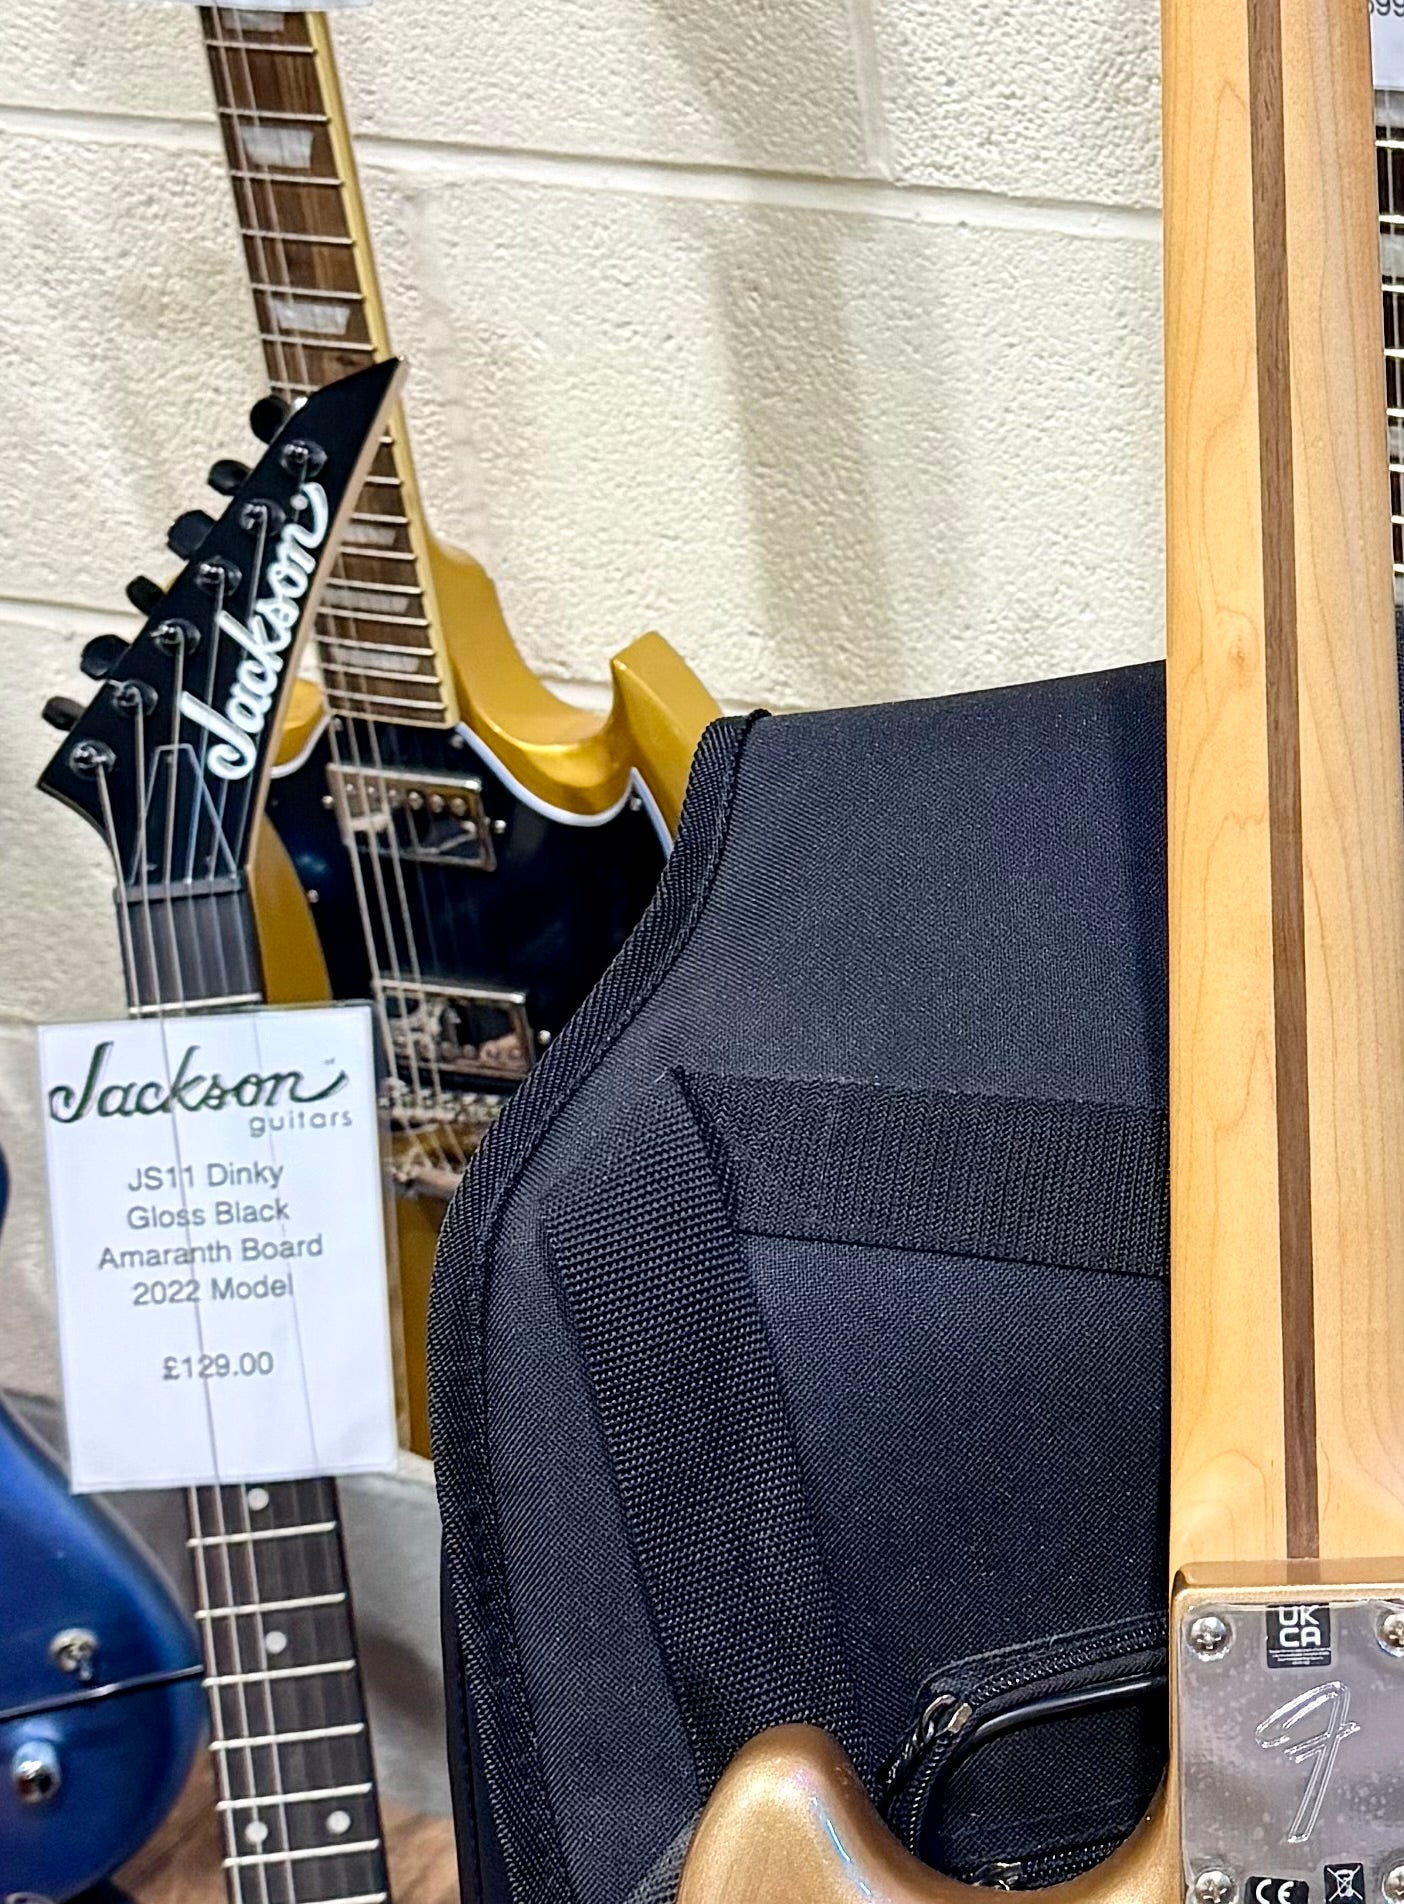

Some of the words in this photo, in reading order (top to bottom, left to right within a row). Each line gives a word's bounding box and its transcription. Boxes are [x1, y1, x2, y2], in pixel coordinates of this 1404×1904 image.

[180, 483, 329, 781] Jackson
[49, 1041, 349, 1124] Jackson
[249, 1110, 353, 1137] guitars
[128, 1166, 195, 1192] JS11
[207, 1162, 284, 1192] Dinky
[127, 1204, 205, 1230] Gloss
[216, 1198, 290, 1226] Black
[98, 1241, 232, 1271] Amaranth
[242, 1234, 324, 1262] Board
[132, 1280, 201, 1306] 2022
[211, 1273, 294, 1300] Model
[162, 1351, 275, 1381] £129.00
[1279, 1627, 1321, 1647] CA
